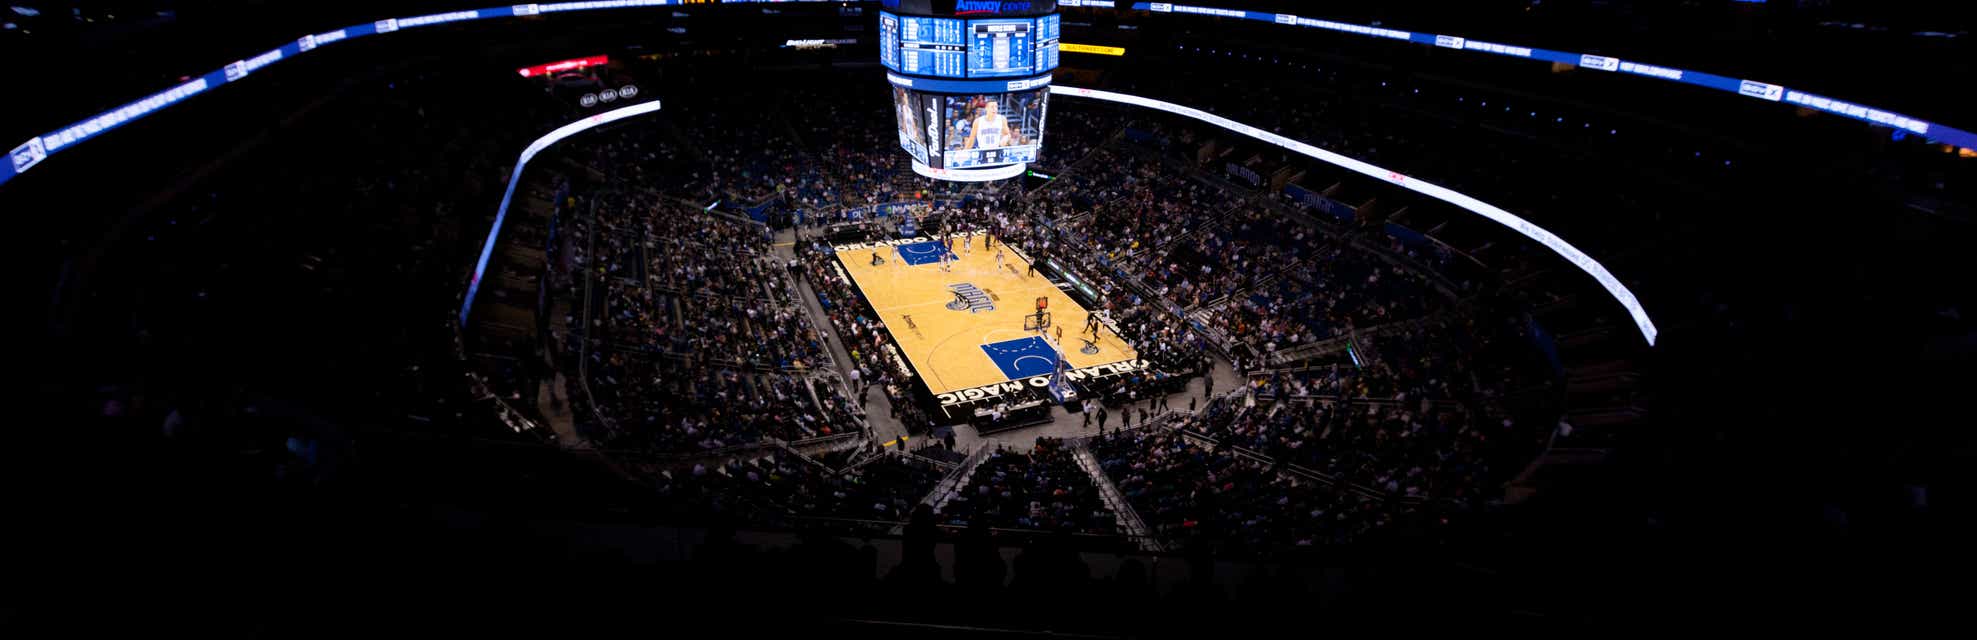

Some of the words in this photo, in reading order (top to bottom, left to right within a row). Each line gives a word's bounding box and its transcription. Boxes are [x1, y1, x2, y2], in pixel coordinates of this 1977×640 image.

[956, 0, 1001, 13] Amway
[834, 236, 928, 252] ORLANDO
[1030, 358, 1149, 388] ORLANO
[937, 380, 1025, 405] MAGIC
